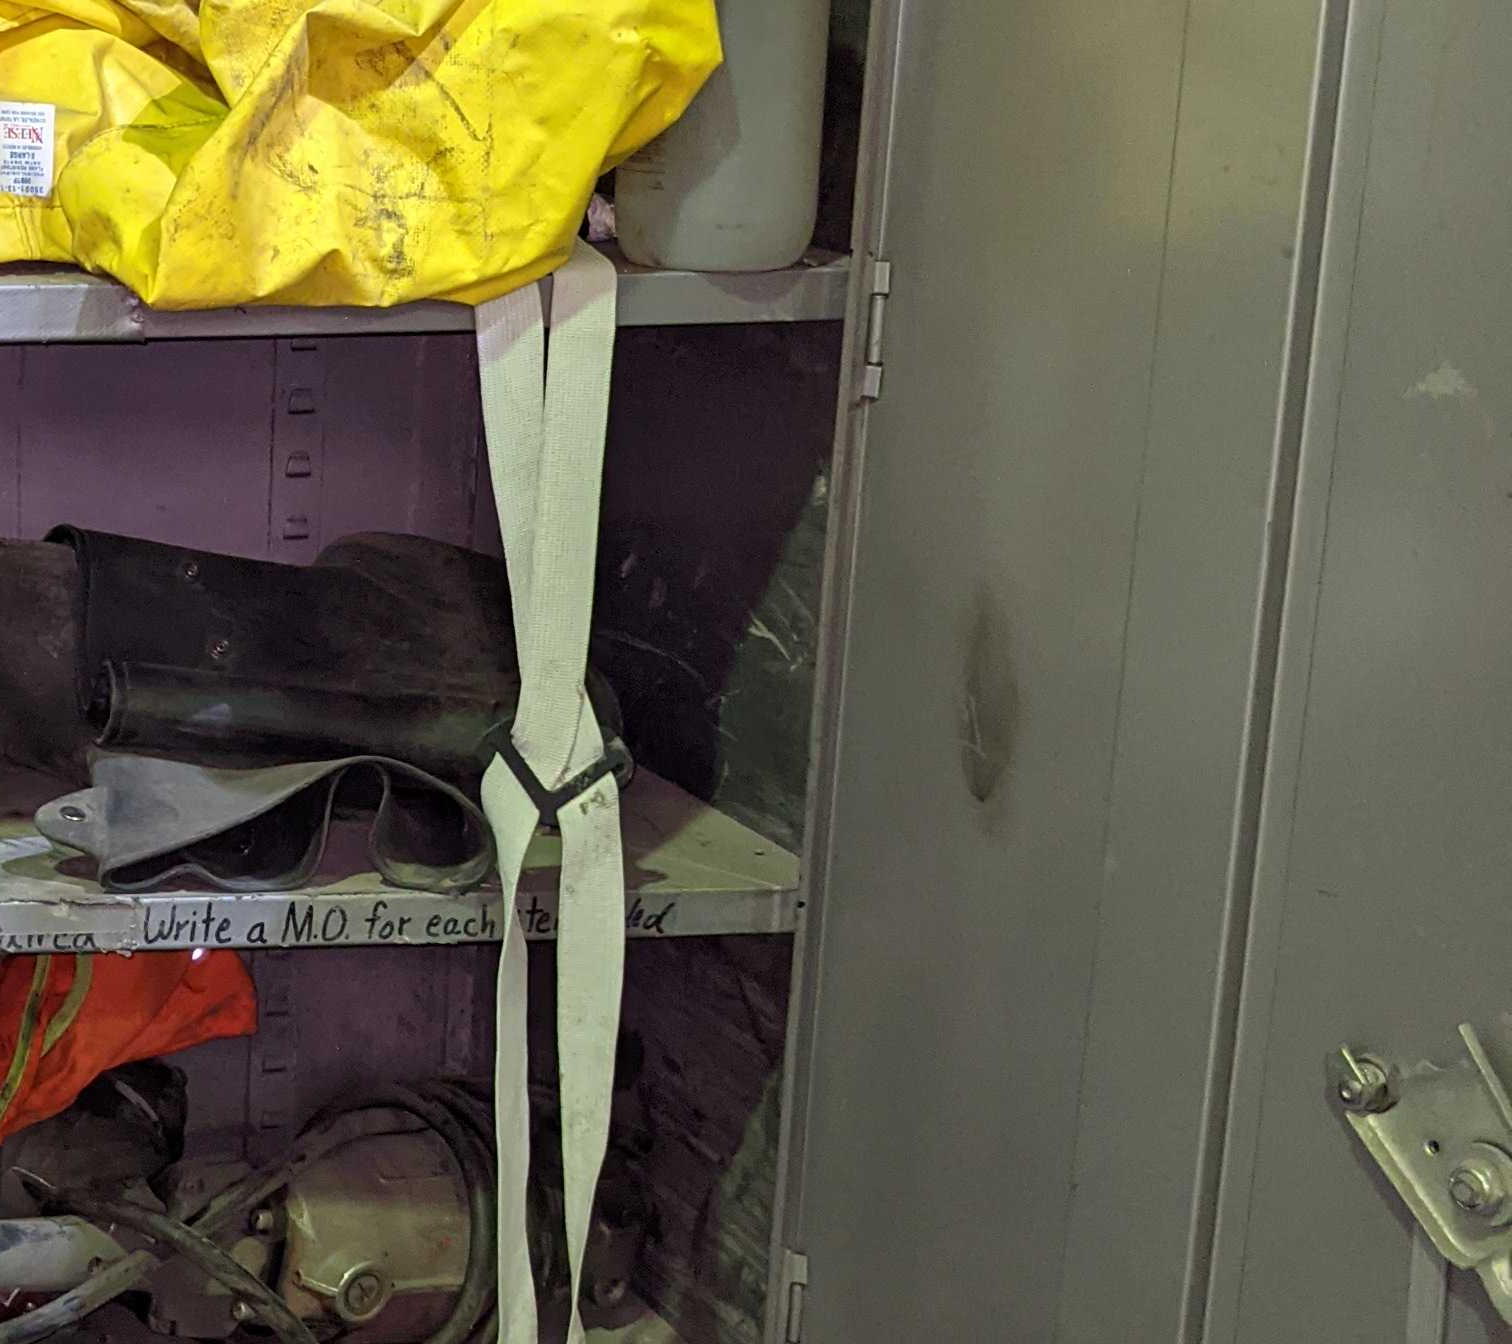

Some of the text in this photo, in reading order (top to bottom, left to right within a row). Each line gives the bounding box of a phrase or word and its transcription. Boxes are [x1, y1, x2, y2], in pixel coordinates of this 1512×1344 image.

[143, 901, 232, 944] Write
[246, 926, 268, 944] a
[281, 897, 350, 942] M.O.
[364, 900, 413, 939] for
[425, 904, 495, 938] each
